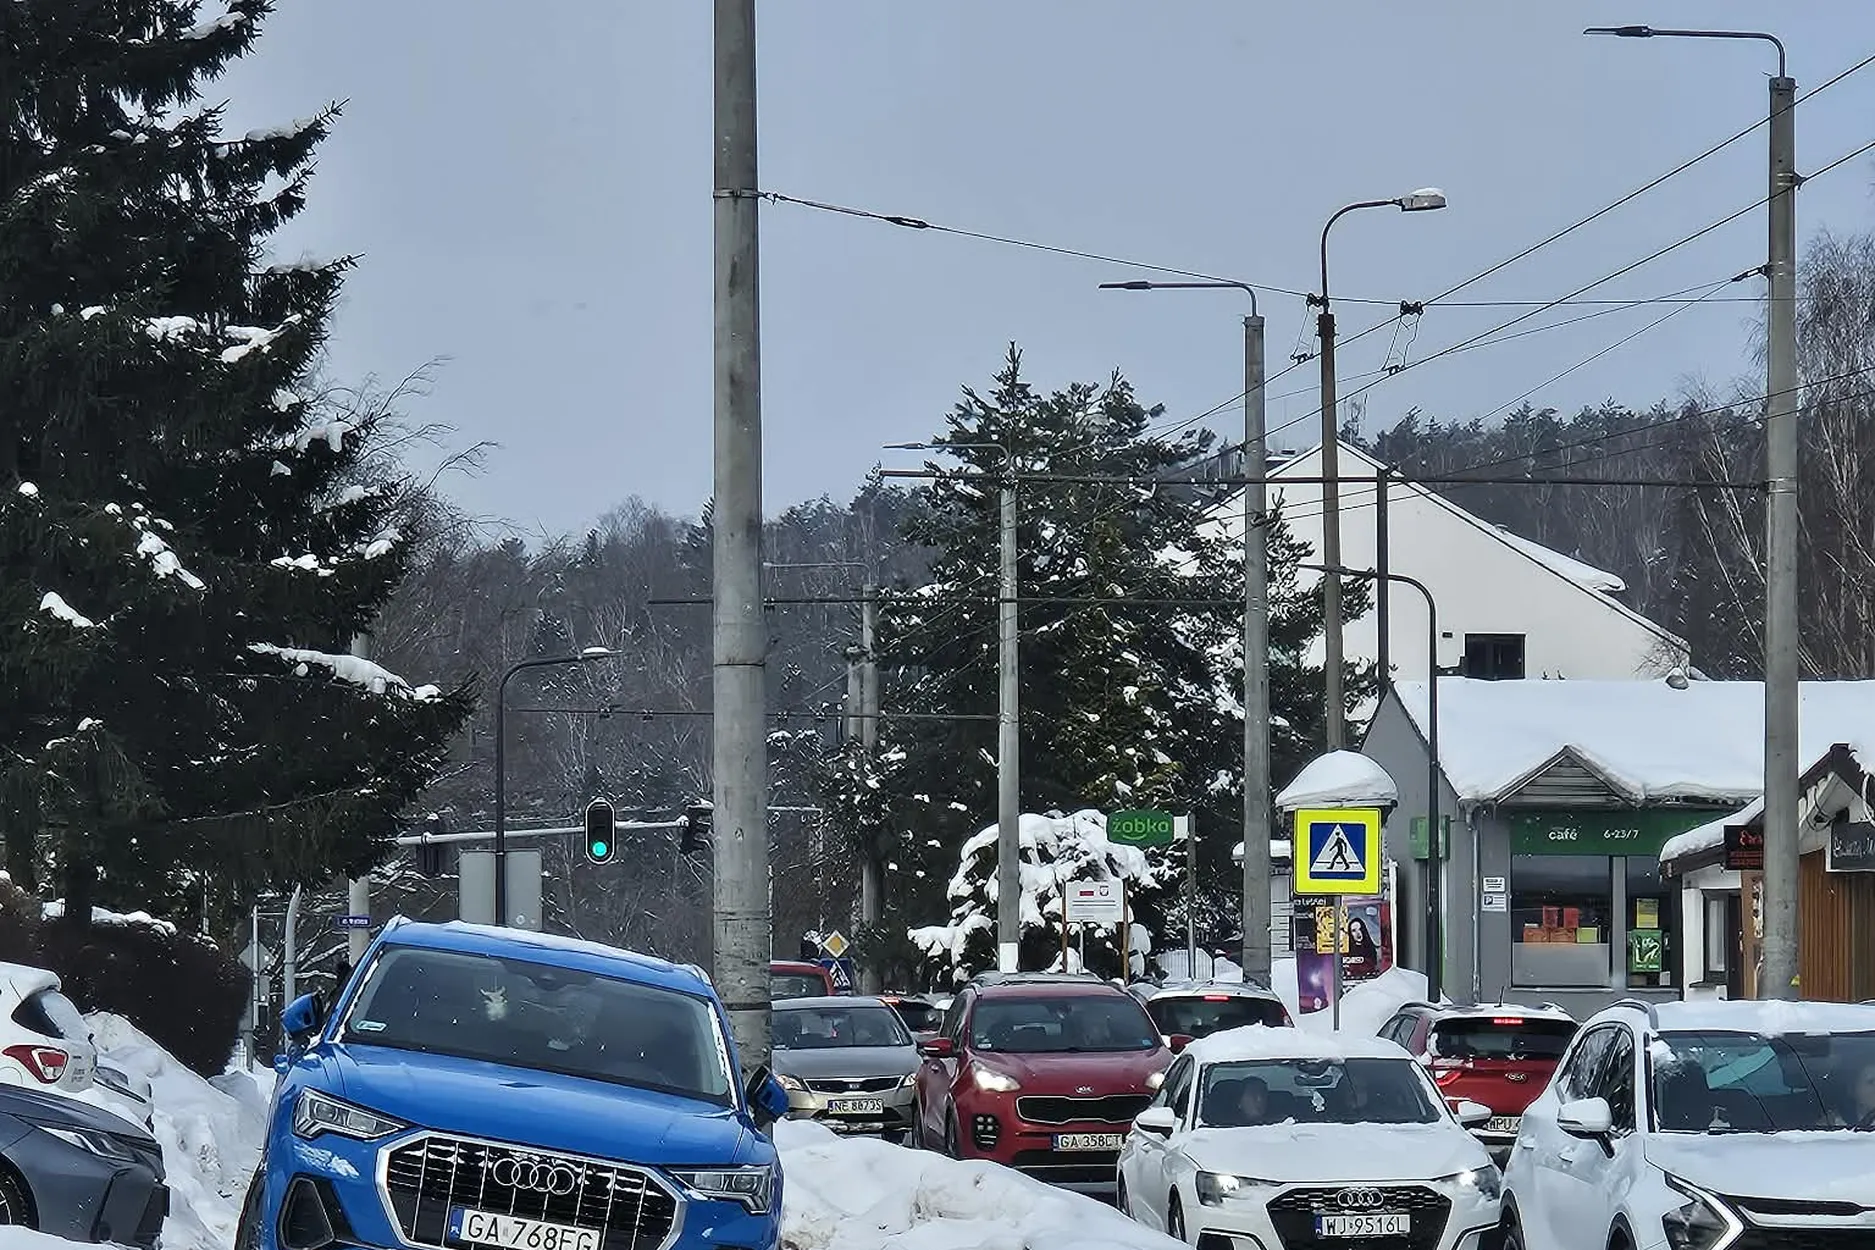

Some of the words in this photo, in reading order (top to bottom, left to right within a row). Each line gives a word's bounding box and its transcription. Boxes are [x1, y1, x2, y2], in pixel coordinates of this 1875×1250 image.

[1548, 828, 1578, 840] café
[1603, 829, 1639, 840] 6-23/7
[1060, 1135, 1079, 1148] GA
[468, 1214, 499, 1243] GA
[1326, 1218, 1346, 1235] WJ
[1354, 1216, 1407, 1234] 9516L
